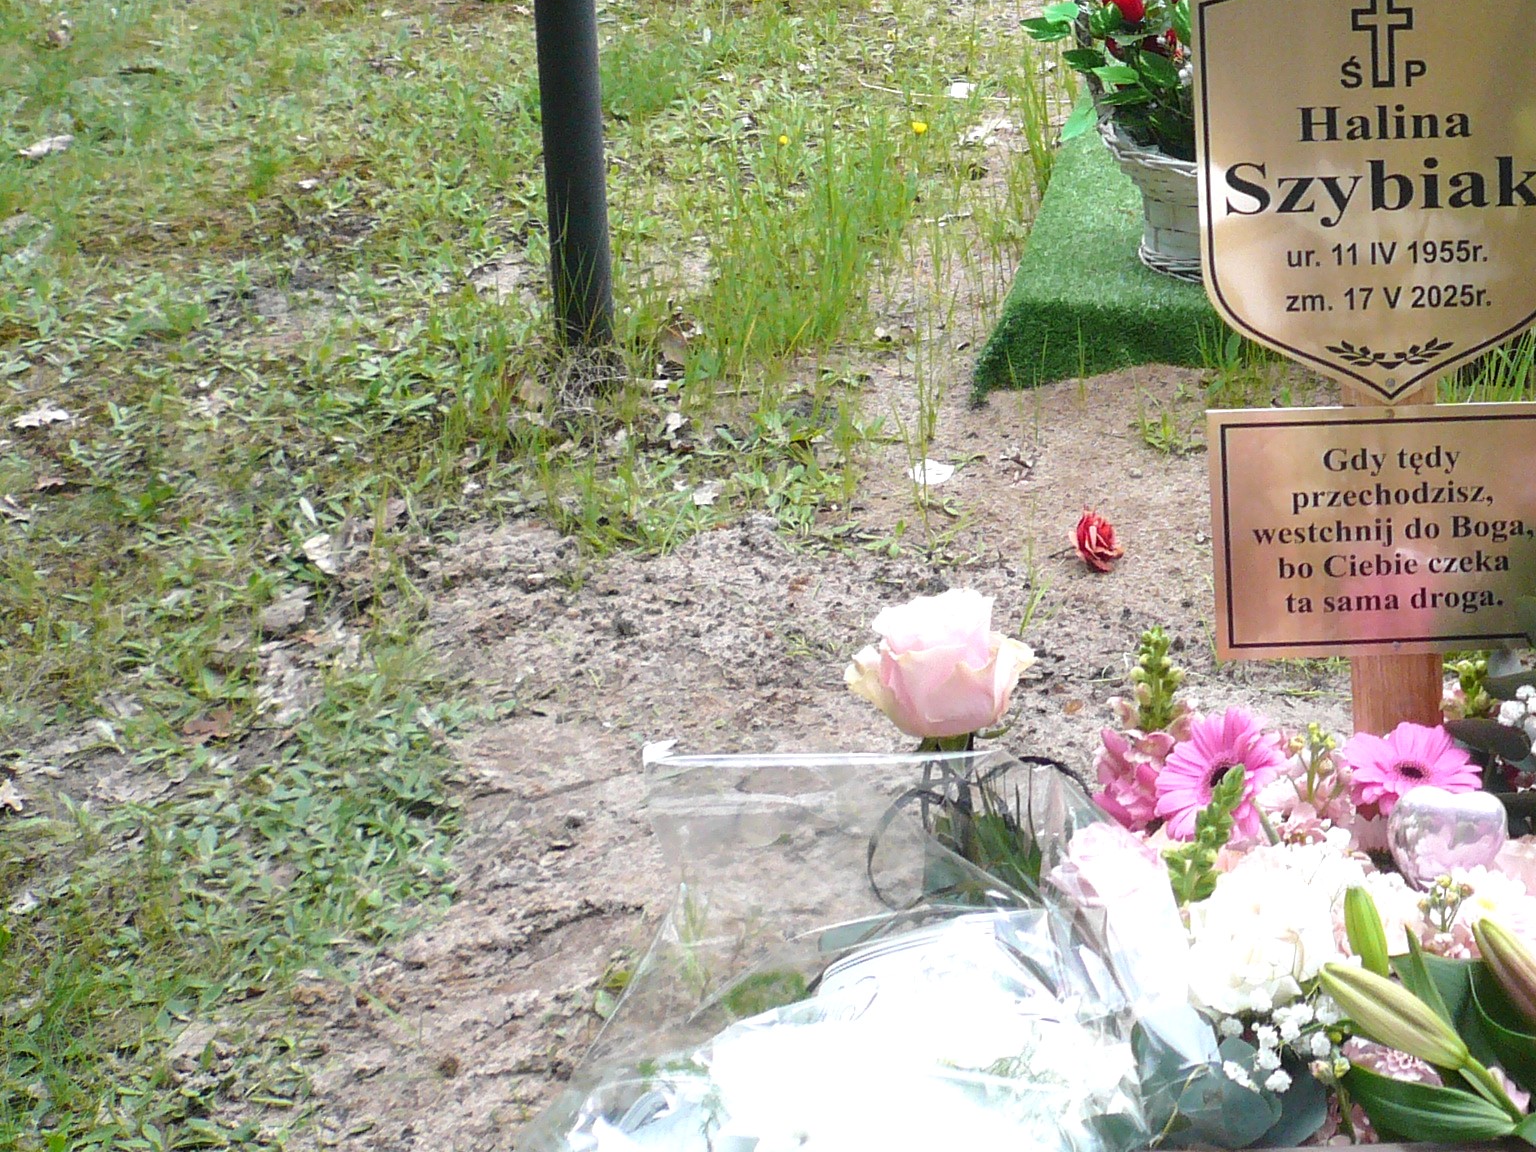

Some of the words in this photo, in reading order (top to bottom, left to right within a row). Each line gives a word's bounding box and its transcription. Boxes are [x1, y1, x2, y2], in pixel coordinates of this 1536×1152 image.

[1340, 56, 1363, 89] Ś
[1405, 60, 1427, 87] P
[1297, 104, 1473, 143] Halina
[1287, 249, 1321, 268] ur.
[1332, 243, 1360, 266] 11
[1370, 242, 1397, 265] IV
[1407, 240, 1488, 265] 1955r.
[1286, 294, 1333, 312] zm.
[1344, 288, 1374, 311] 17
[1382, 286, 1402, 309] V
[1411, 285, 1492, 309] 2025r.
[1322, 448, 1387, 477] Gdy
[1397, 445, 1460, 475] tędy
[1292, 481, 1494, 515] przechodzisz,
[1253, 518, 1393, 547] westchnij
[1404, 517, 1440, 541] do
[1452, 515, 1535, 543] Boga,
[1278, 557, 1313, 579] bo
[1323, 553, 1418, 578] Ciebie
[1428, 551, 1510, 574] czeka
[1286, 593, 1313, 614] ta
[1323, 593, 1400, 613] sama
[1410, 587, 1504, 614] droga.
